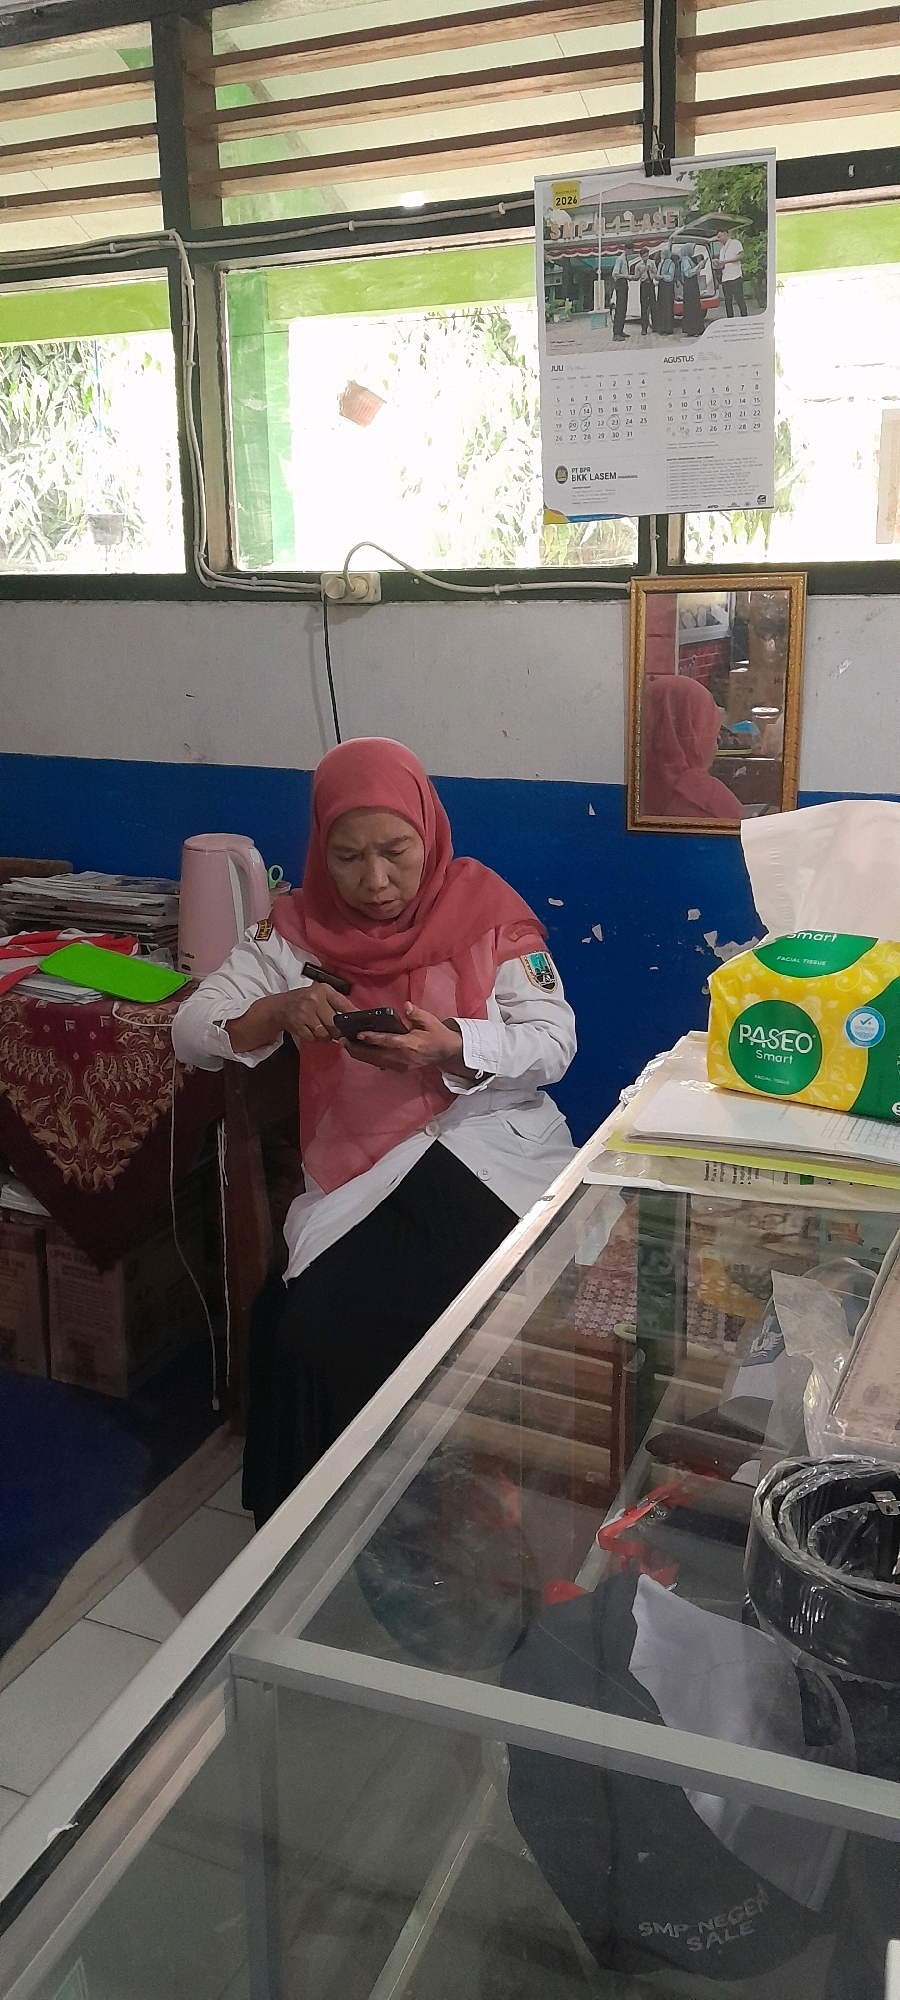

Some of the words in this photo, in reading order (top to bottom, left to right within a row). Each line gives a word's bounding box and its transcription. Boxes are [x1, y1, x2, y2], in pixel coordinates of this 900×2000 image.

[555, 195, 578, 206] 2026
[550, 219, 588, 240] SMP
[630, 210, 682, 232] LASE
[663, 355, 694, 363] AGUSTUS
[590, 472, 616, 480] LASEM
[777, 955, 800, 963] FACIAL
[802, 958, 827, 966] TISSUE
[739, 1024, 813, 1053] PASEO
[756, 1050, 793, 1065] Smart
[754, 1074, 772, 1082] FACIAL
[773, 1077, 789, 1085] TISSUE
[638, 1922, 689, 1938] SMP
[686, 1920, 755, 1952] SALE
